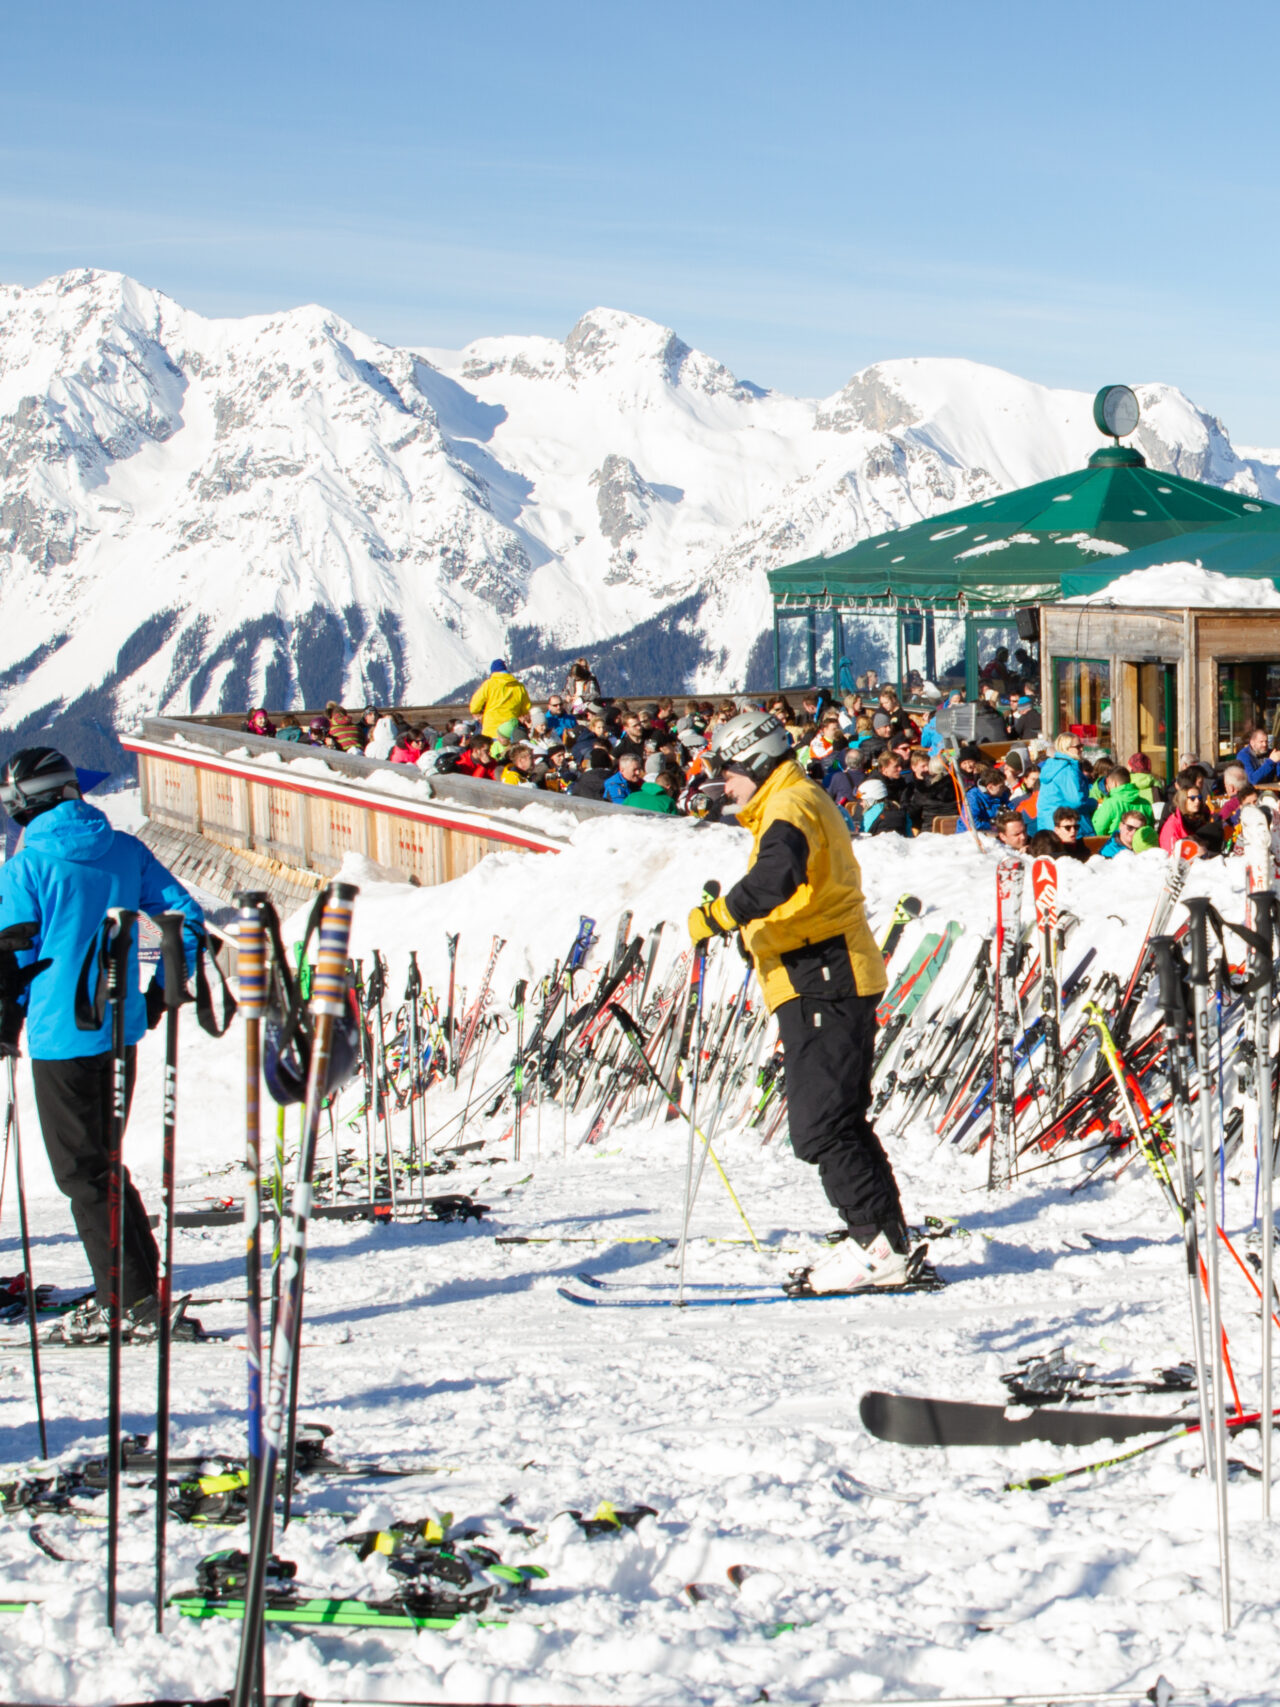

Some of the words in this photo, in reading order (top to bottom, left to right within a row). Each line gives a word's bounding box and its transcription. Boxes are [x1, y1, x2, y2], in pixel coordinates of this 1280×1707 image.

[720, 731, 760, 761] uvex
[1200, 1011, 1210, 1091] HEAD
[1260, 996, 1271, 1068] HEAD
[113, 1058, 125, 1119] LEKI
[164, 1063, 177, 1127] LEKI
